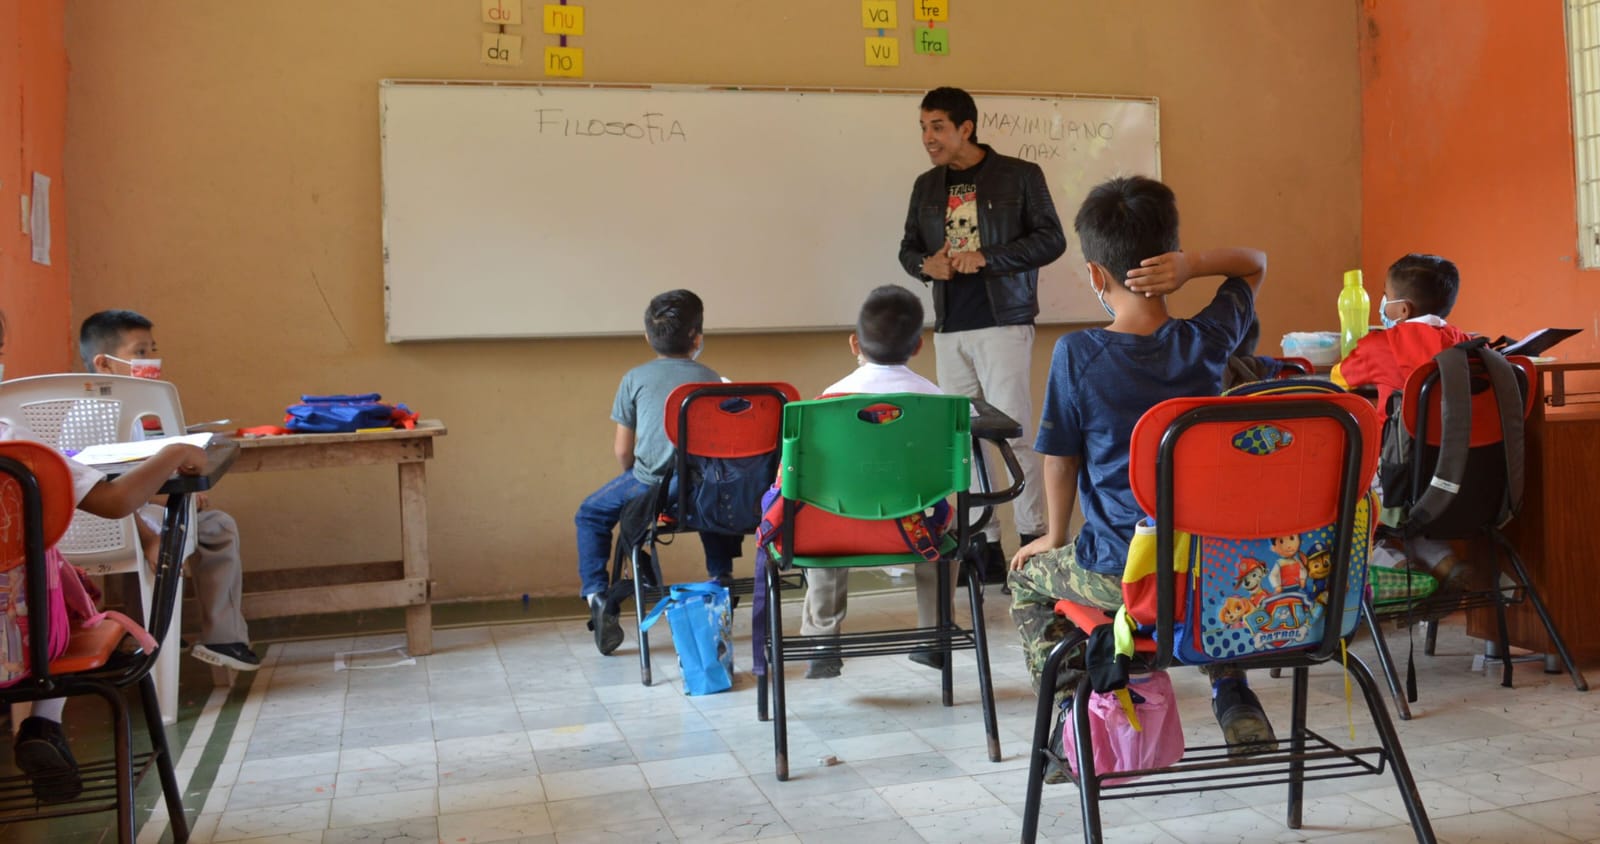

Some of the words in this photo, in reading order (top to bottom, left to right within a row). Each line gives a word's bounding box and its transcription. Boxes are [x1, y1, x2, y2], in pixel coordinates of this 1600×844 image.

[487, 0, 511, 21] du
[869, 8, 889, 24] va
[920, 0, 940, 17] fre
[552, 9, 575, 29] nu
[487, 38, 509, 62] da
[920, 31, 942, 52] fra
[550, 52, 573, 71] no
[871, 45, 890, 59] vu
[981, 111, 1113, 141] MAXIMILIANO
[1018, 142, 1061, 161] MAX
[1260, 630, 1301, 642] PATROL
